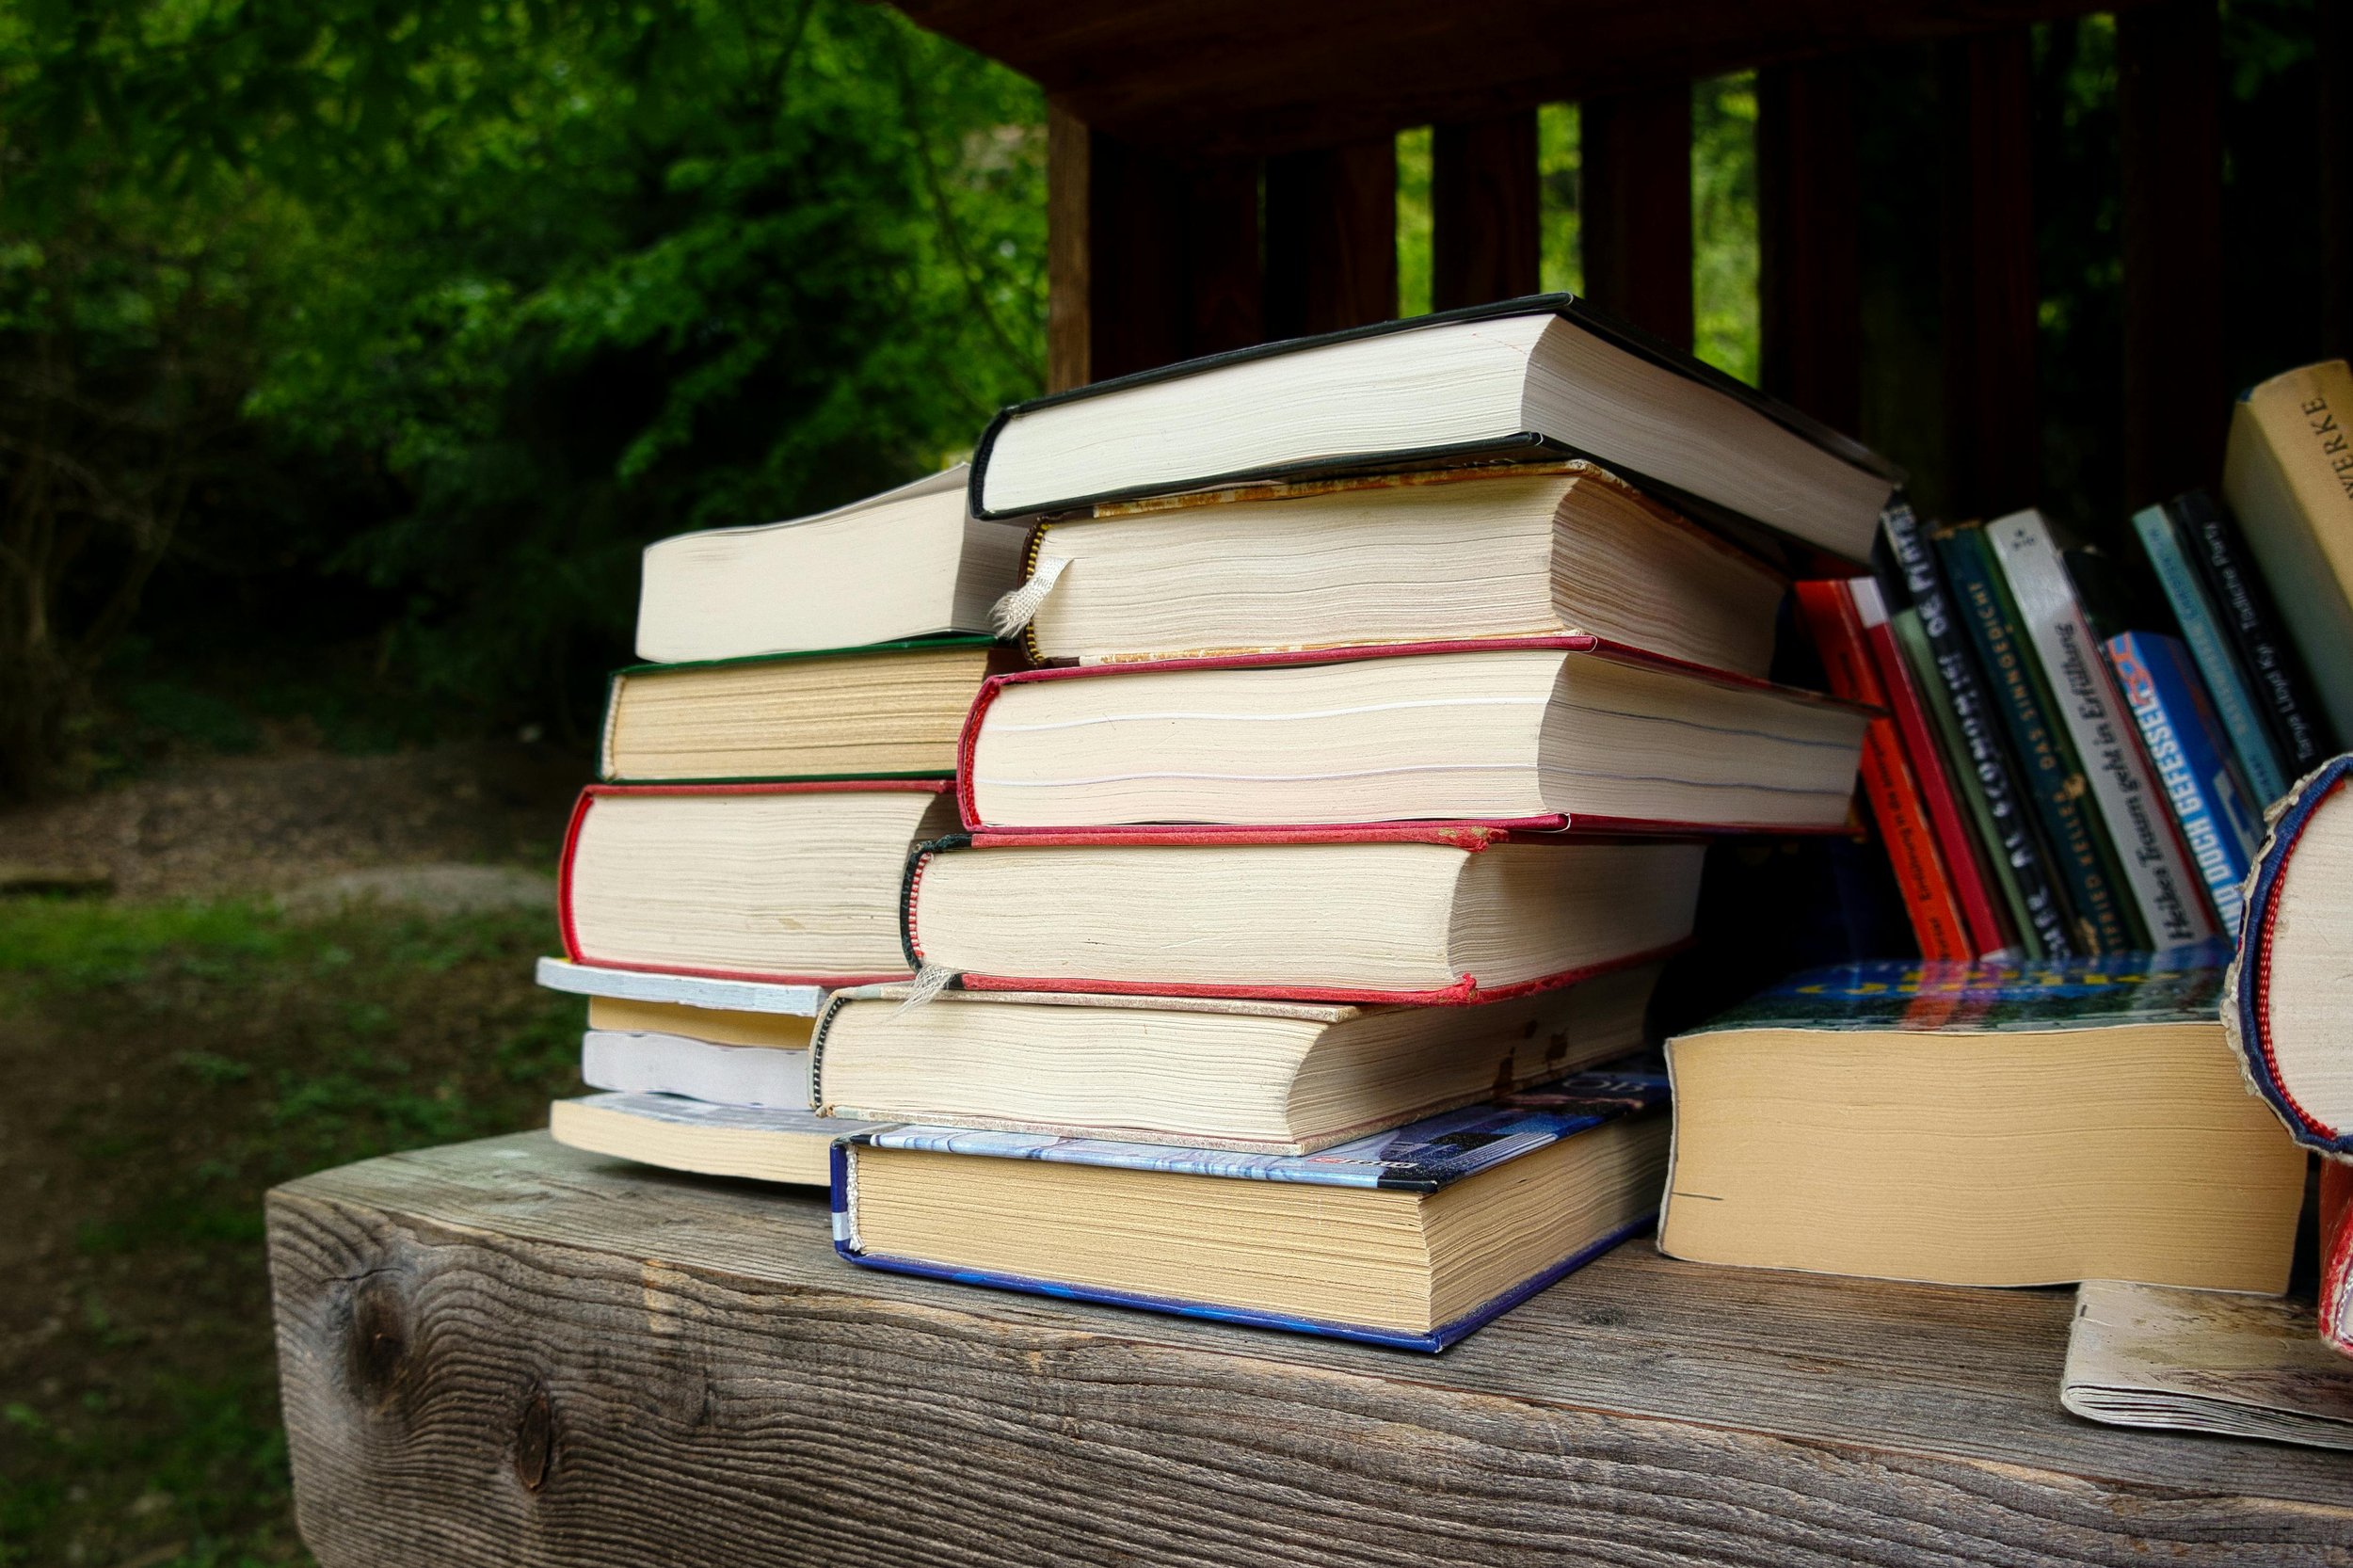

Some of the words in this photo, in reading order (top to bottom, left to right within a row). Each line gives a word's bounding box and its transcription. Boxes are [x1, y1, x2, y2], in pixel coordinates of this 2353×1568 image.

[2201, 520, 2232, 567] Party
[1968, 579, 2036, 721] SINNGEDICHT
[2053, 622, 2105, 724] Erfüllung
[2266, 668, 2298, 712] Lloyd
[2028, 728, 2057, 772] DAS
[2090, 723, 2113, 746] in
[2101, 746, 2138, 792] geht
[2055, 790, 2093, 867] KELLER
[2124, 796, 2162, 863] Traum
[2184, 818, 2230, 885] DOCH
[2150, 866, 2192, 941] Heikes
